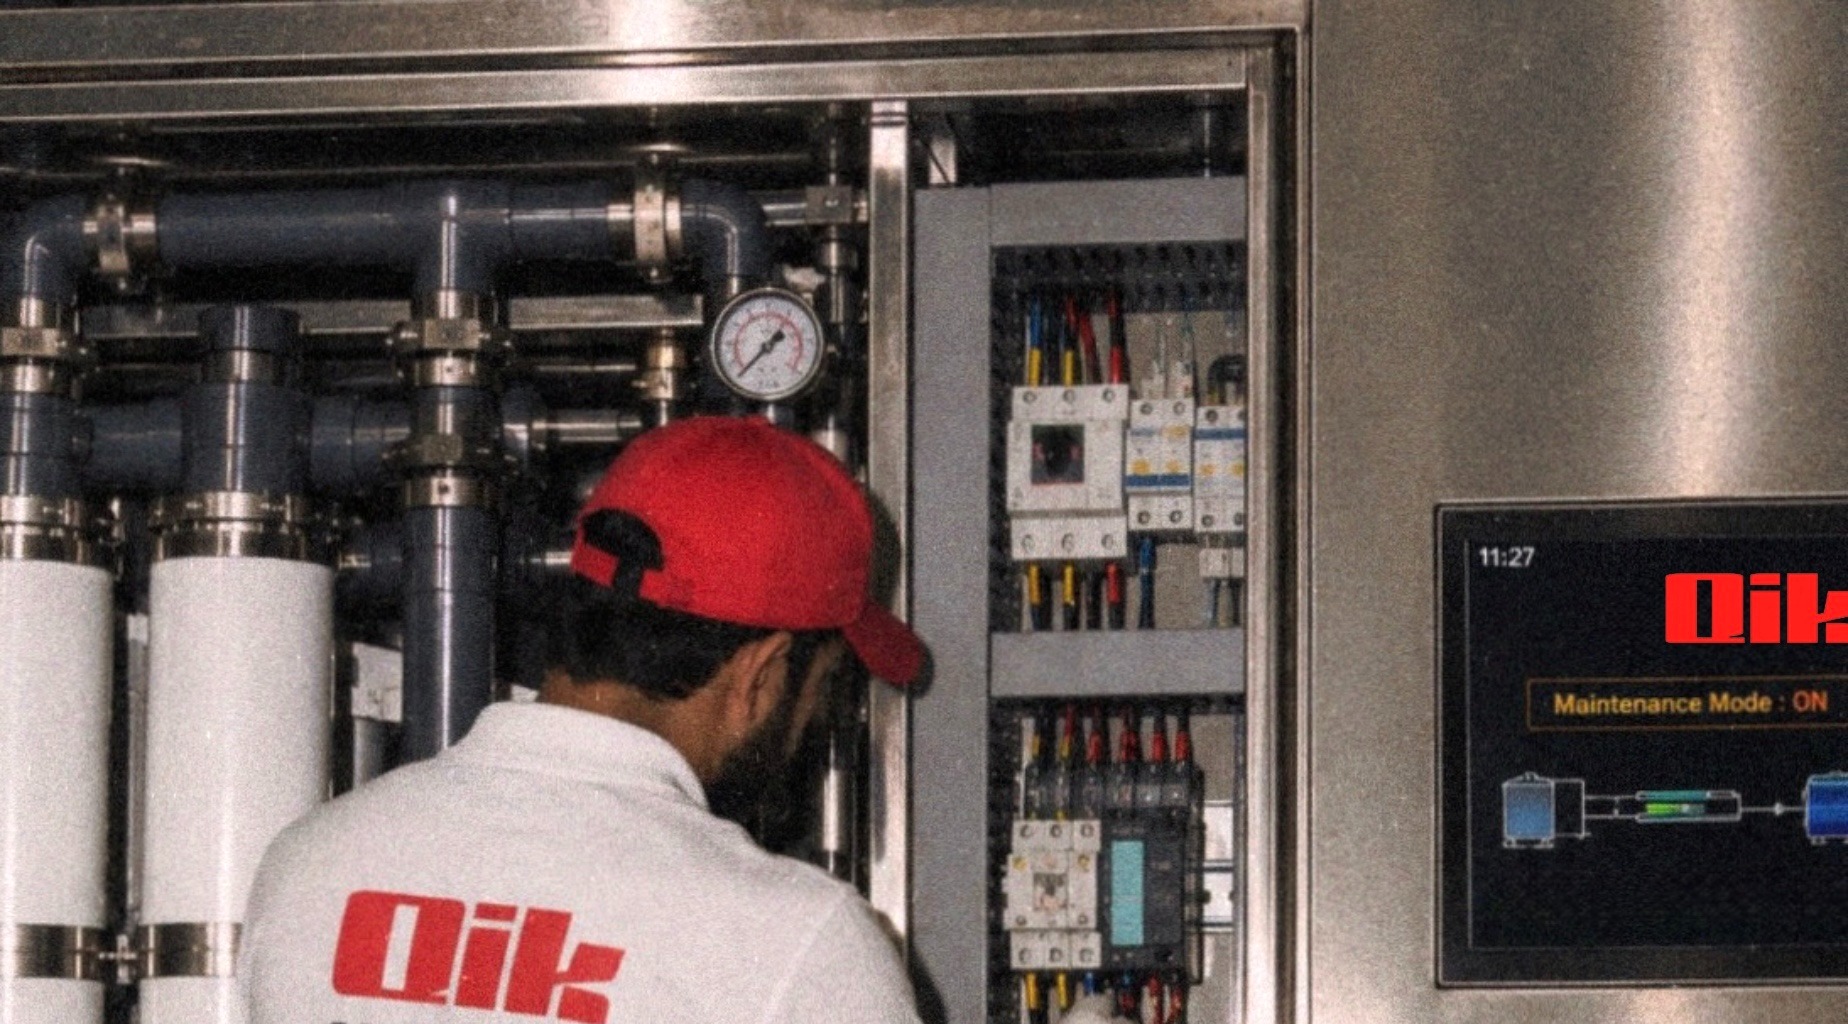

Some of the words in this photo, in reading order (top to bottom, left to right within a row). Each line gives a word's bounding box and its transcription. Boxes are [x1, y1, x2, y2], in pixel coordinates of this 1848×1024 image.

[1480, 546, 1535, 567] 11:27
[1665, 573, 1848, 643] Qik
[1553, 693, 1701, 714] Maintenance
[1709, 692, 1772, 713] Mode
[1792, 691, 1828, 712] ON
